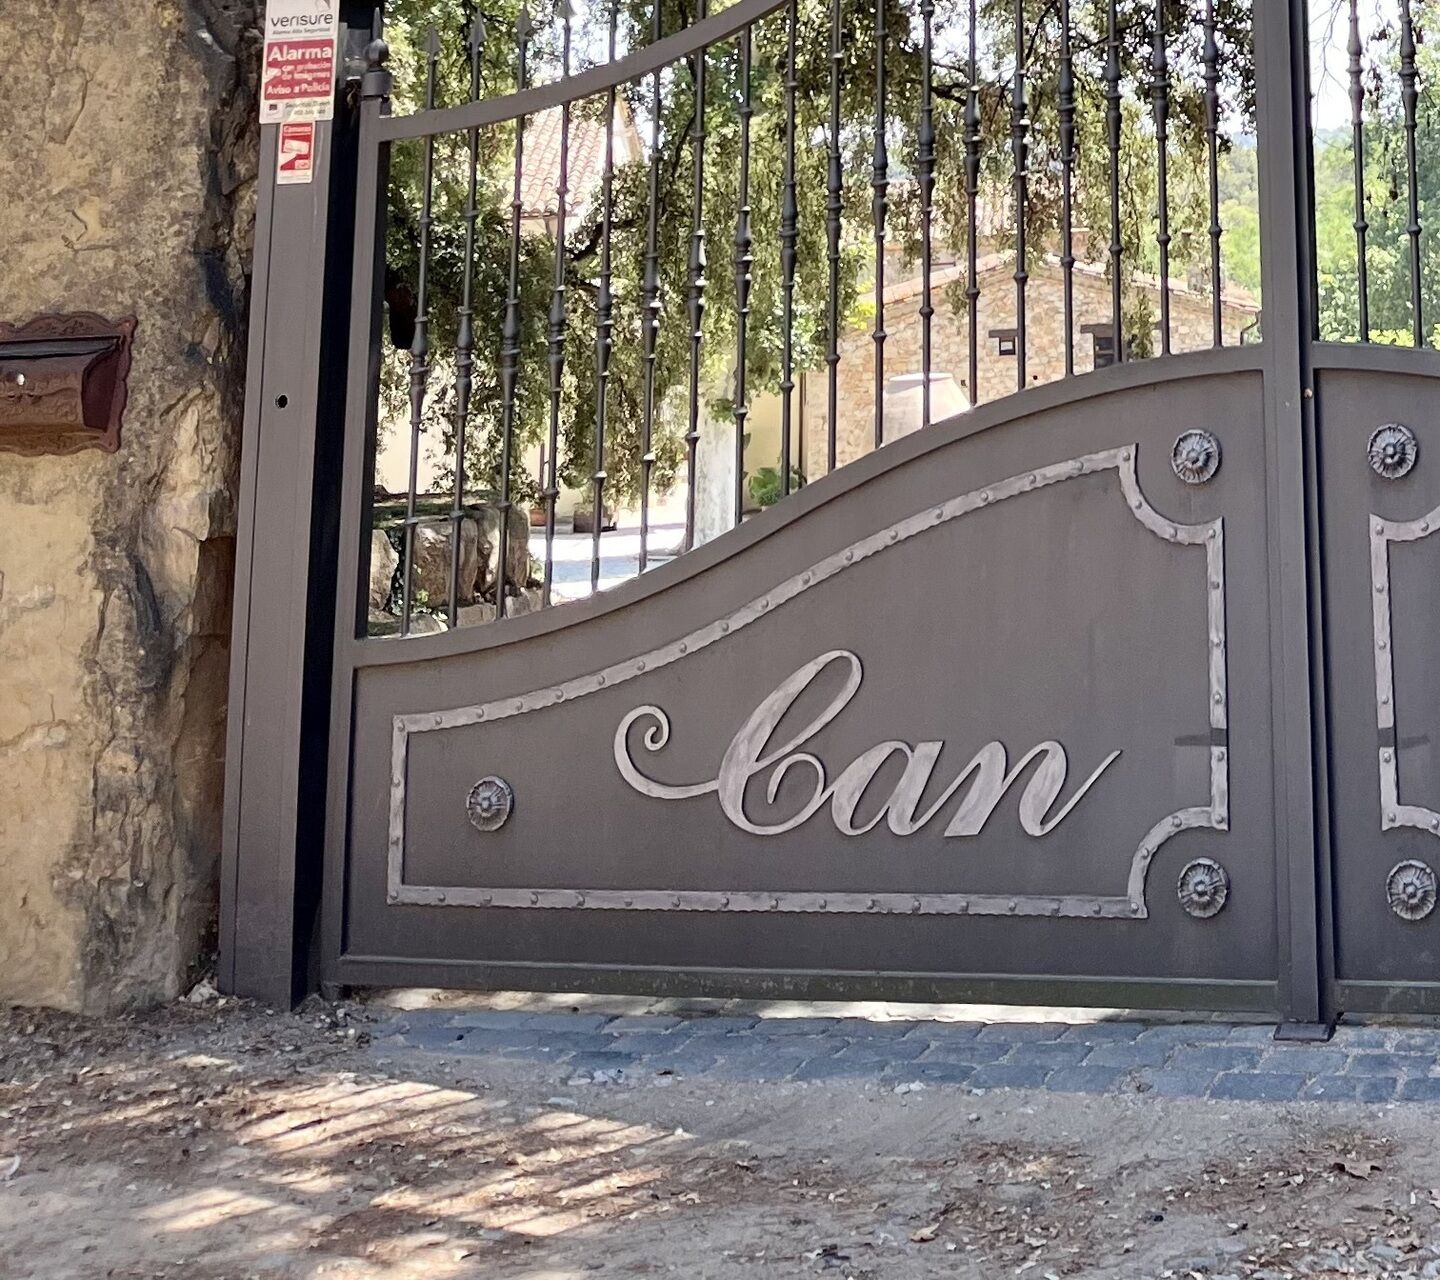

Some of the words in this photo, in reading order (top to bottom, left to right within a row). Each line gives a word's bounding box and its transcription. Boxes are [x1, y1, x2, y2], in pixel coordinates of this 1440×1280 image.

[271, 13, 333, 27] verisure
[268, 44, 332, 61] Alarma
[613, 648, 1123, 838] Can
